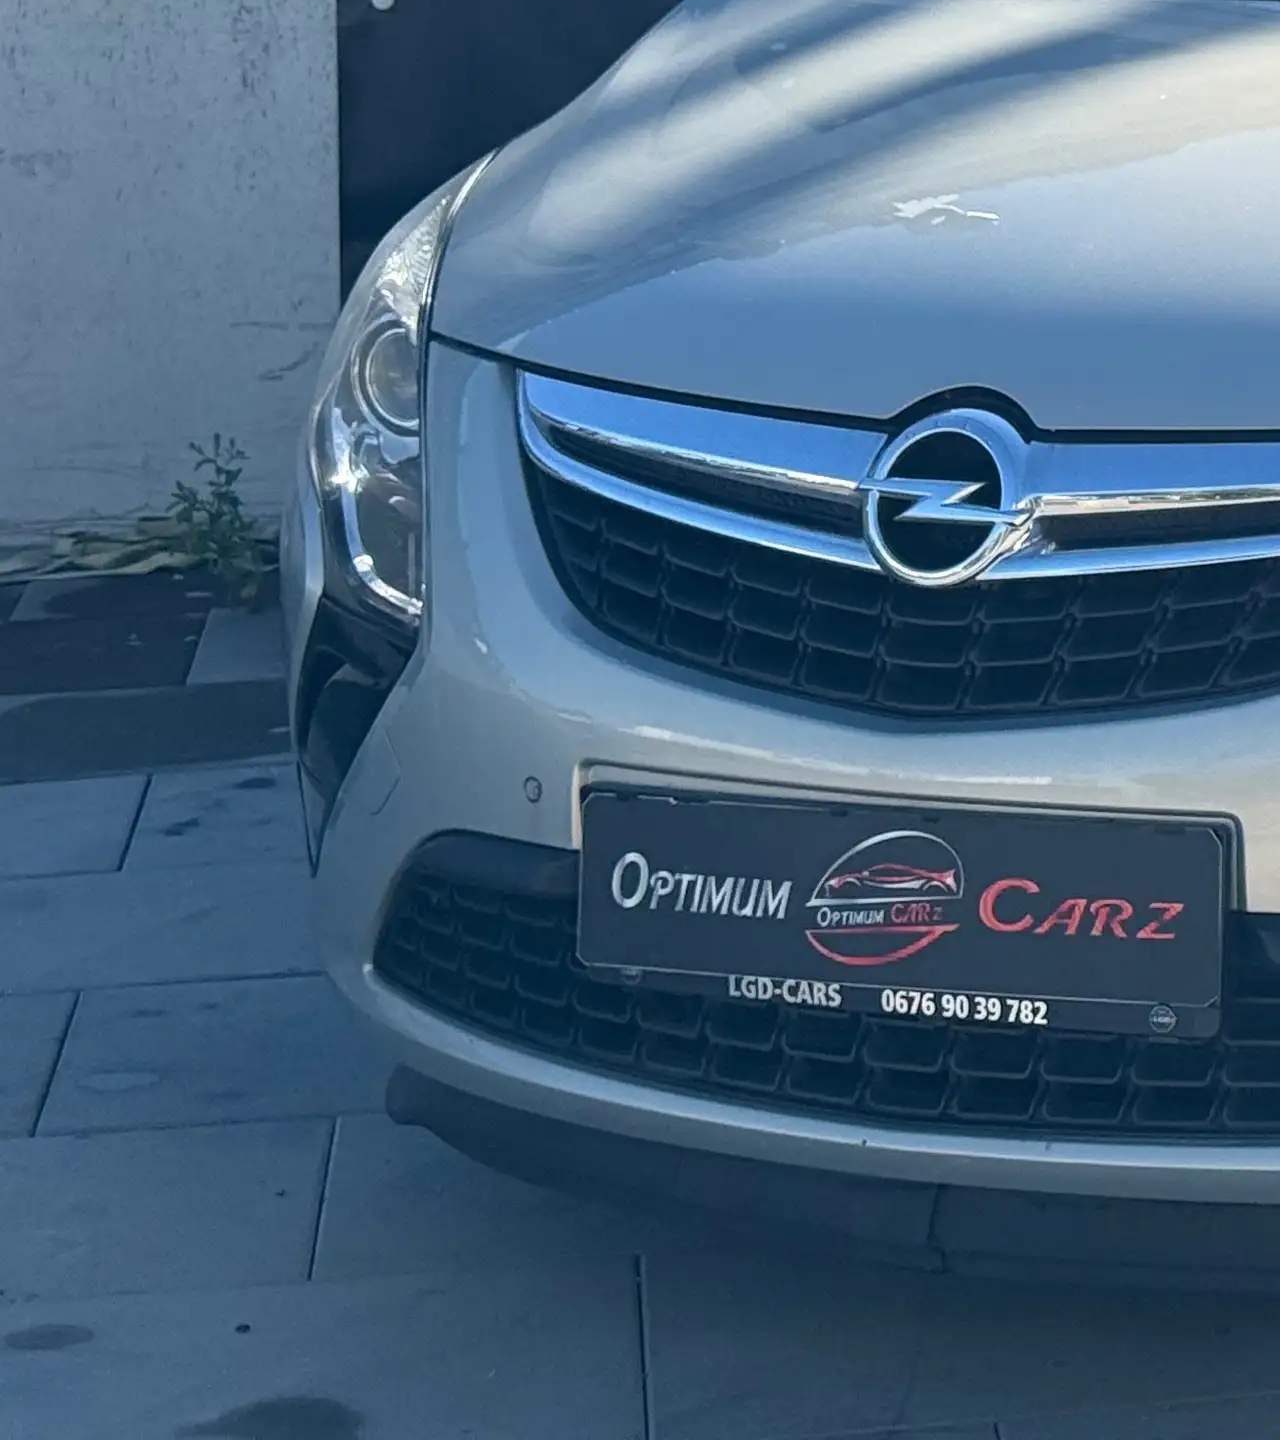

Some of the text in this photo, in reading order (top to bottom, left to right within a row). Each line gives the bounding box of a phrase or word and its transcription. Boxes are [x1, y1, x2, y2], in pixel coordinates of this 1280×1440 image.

[611, 851, 1185, 940] OPTIMUM CARZ
[816, 906, 885, 927] OPTIMUM
[728, 975, 1048, 1025] LGD-CARS 0676 90 39 782
